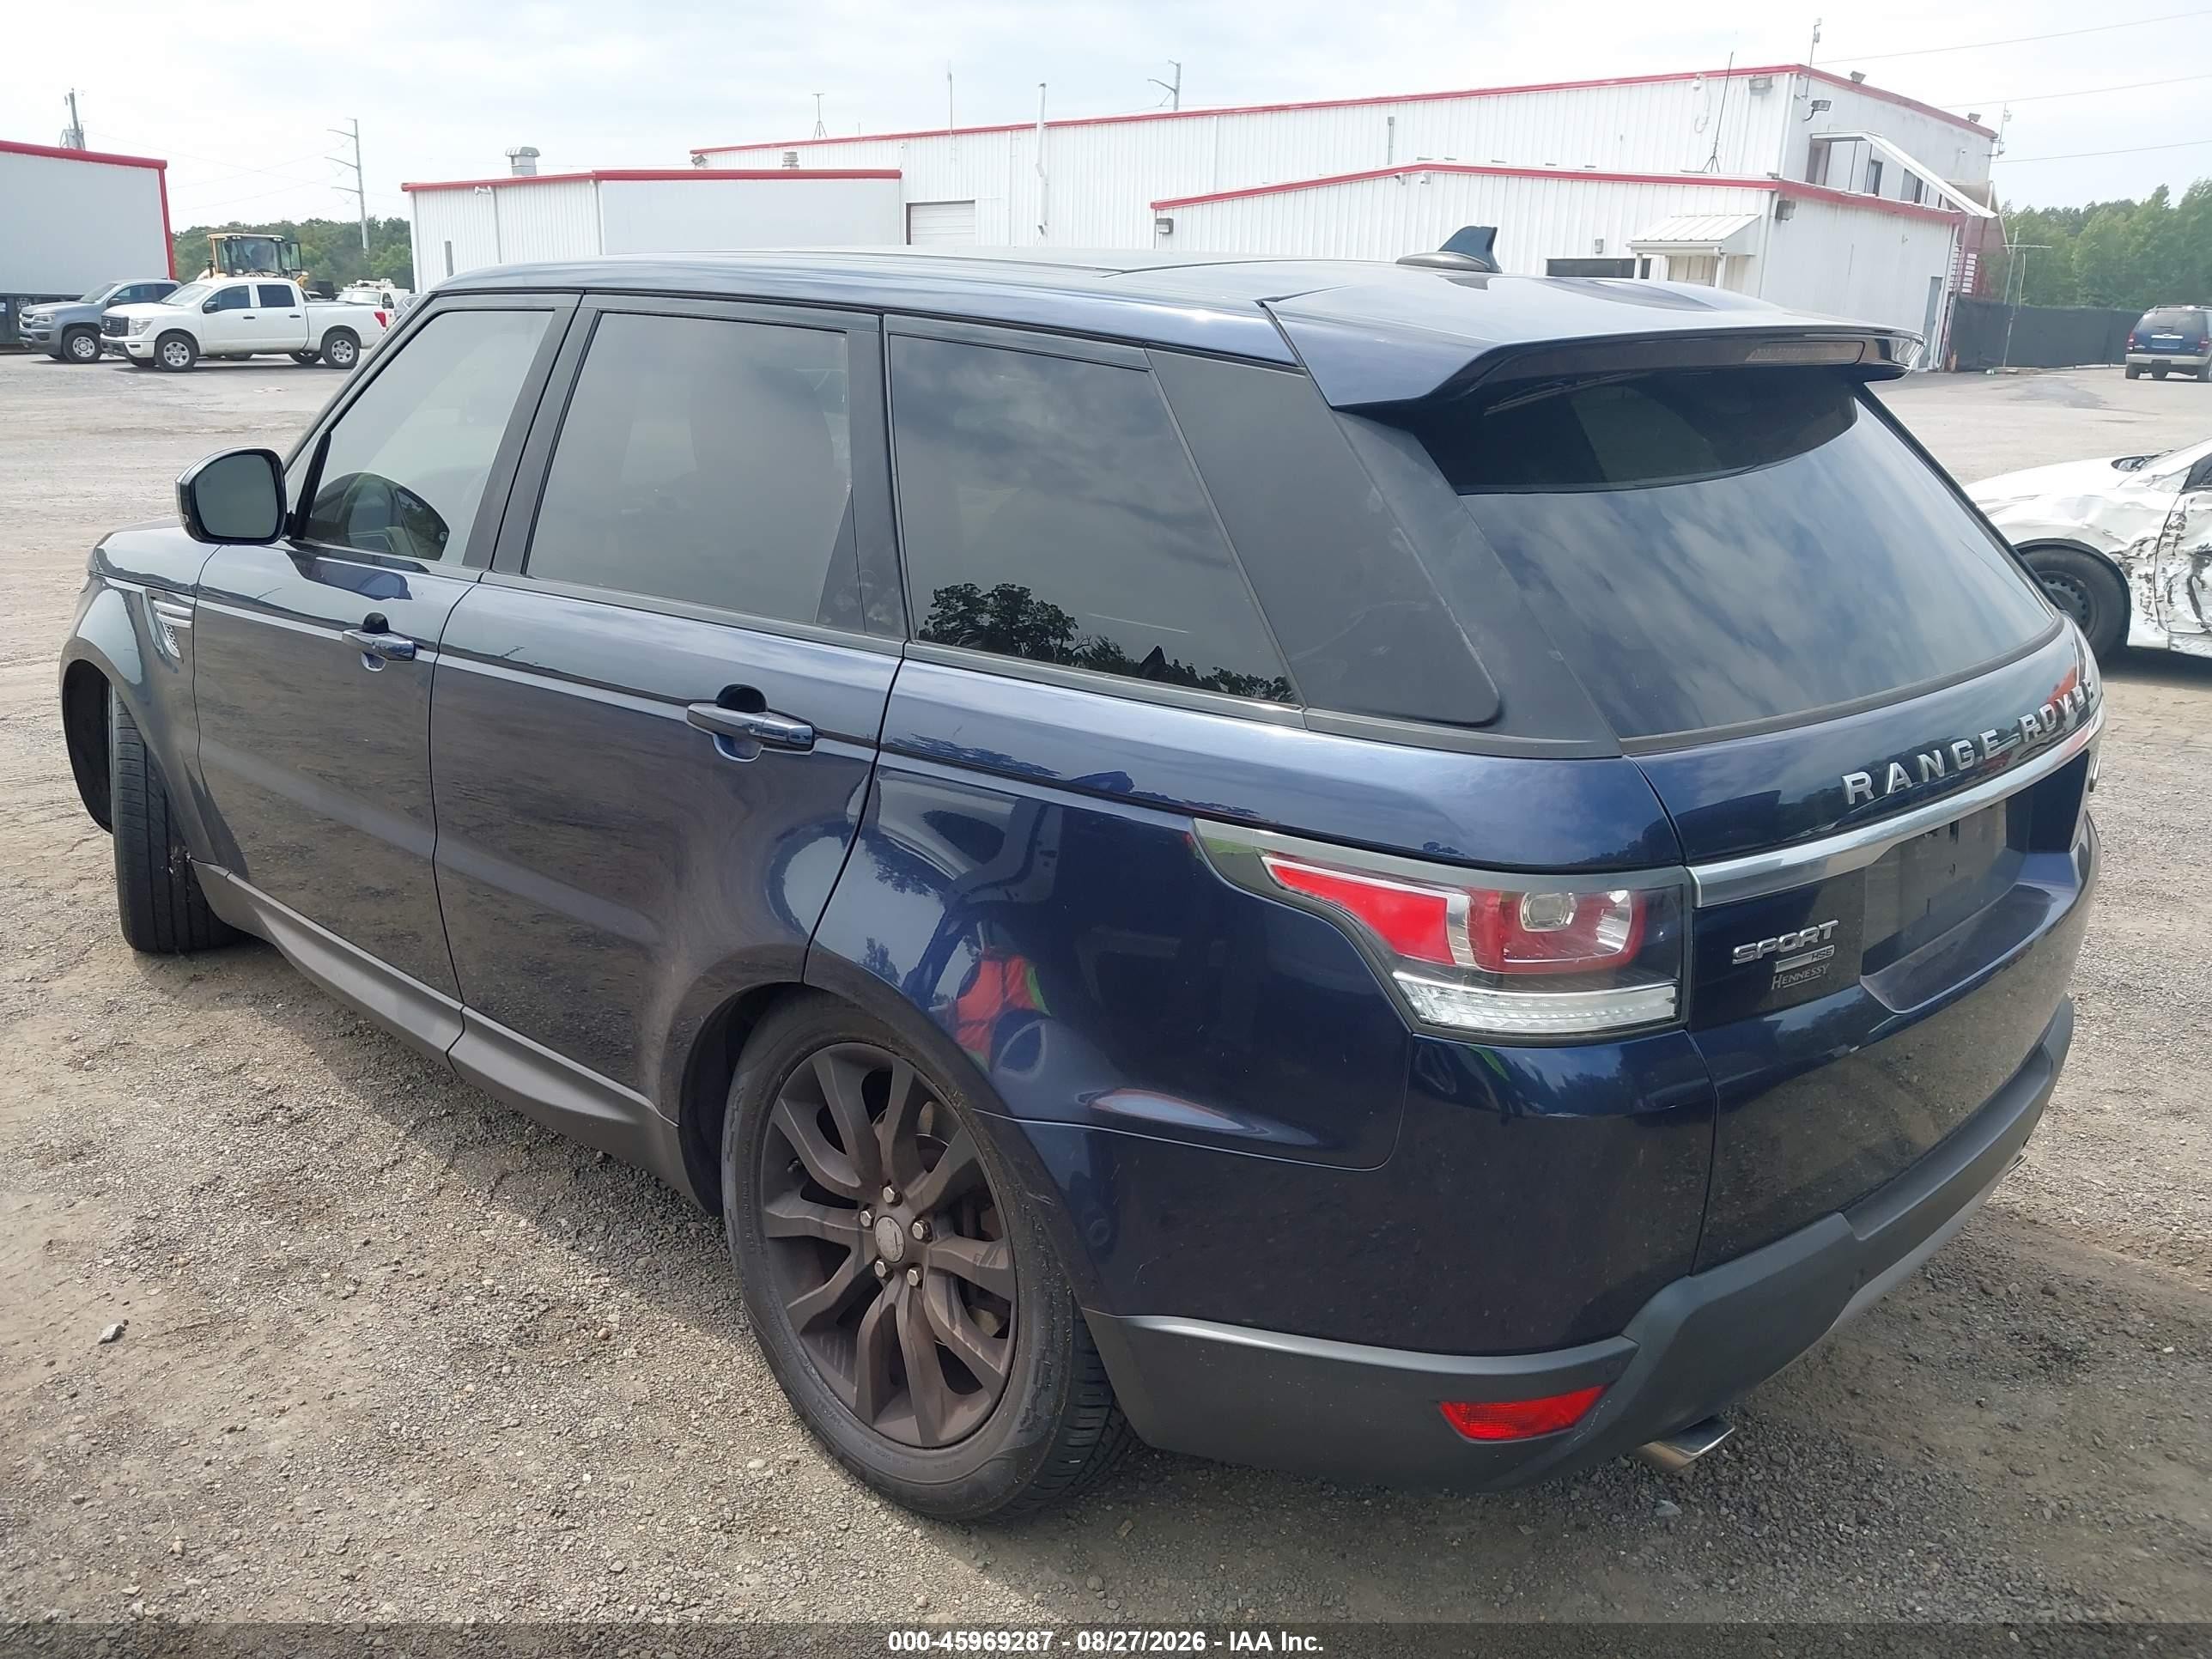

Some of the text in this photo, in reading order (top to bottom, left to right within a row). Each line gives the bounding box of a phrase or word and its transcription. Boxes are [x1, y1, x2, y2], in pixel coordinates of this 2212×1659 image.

[1841, 729, 2012, 805] RANGE
[1732, 920, 1839, 964] SPORT
[1771, 963, 1830, 990] HENNESSY
